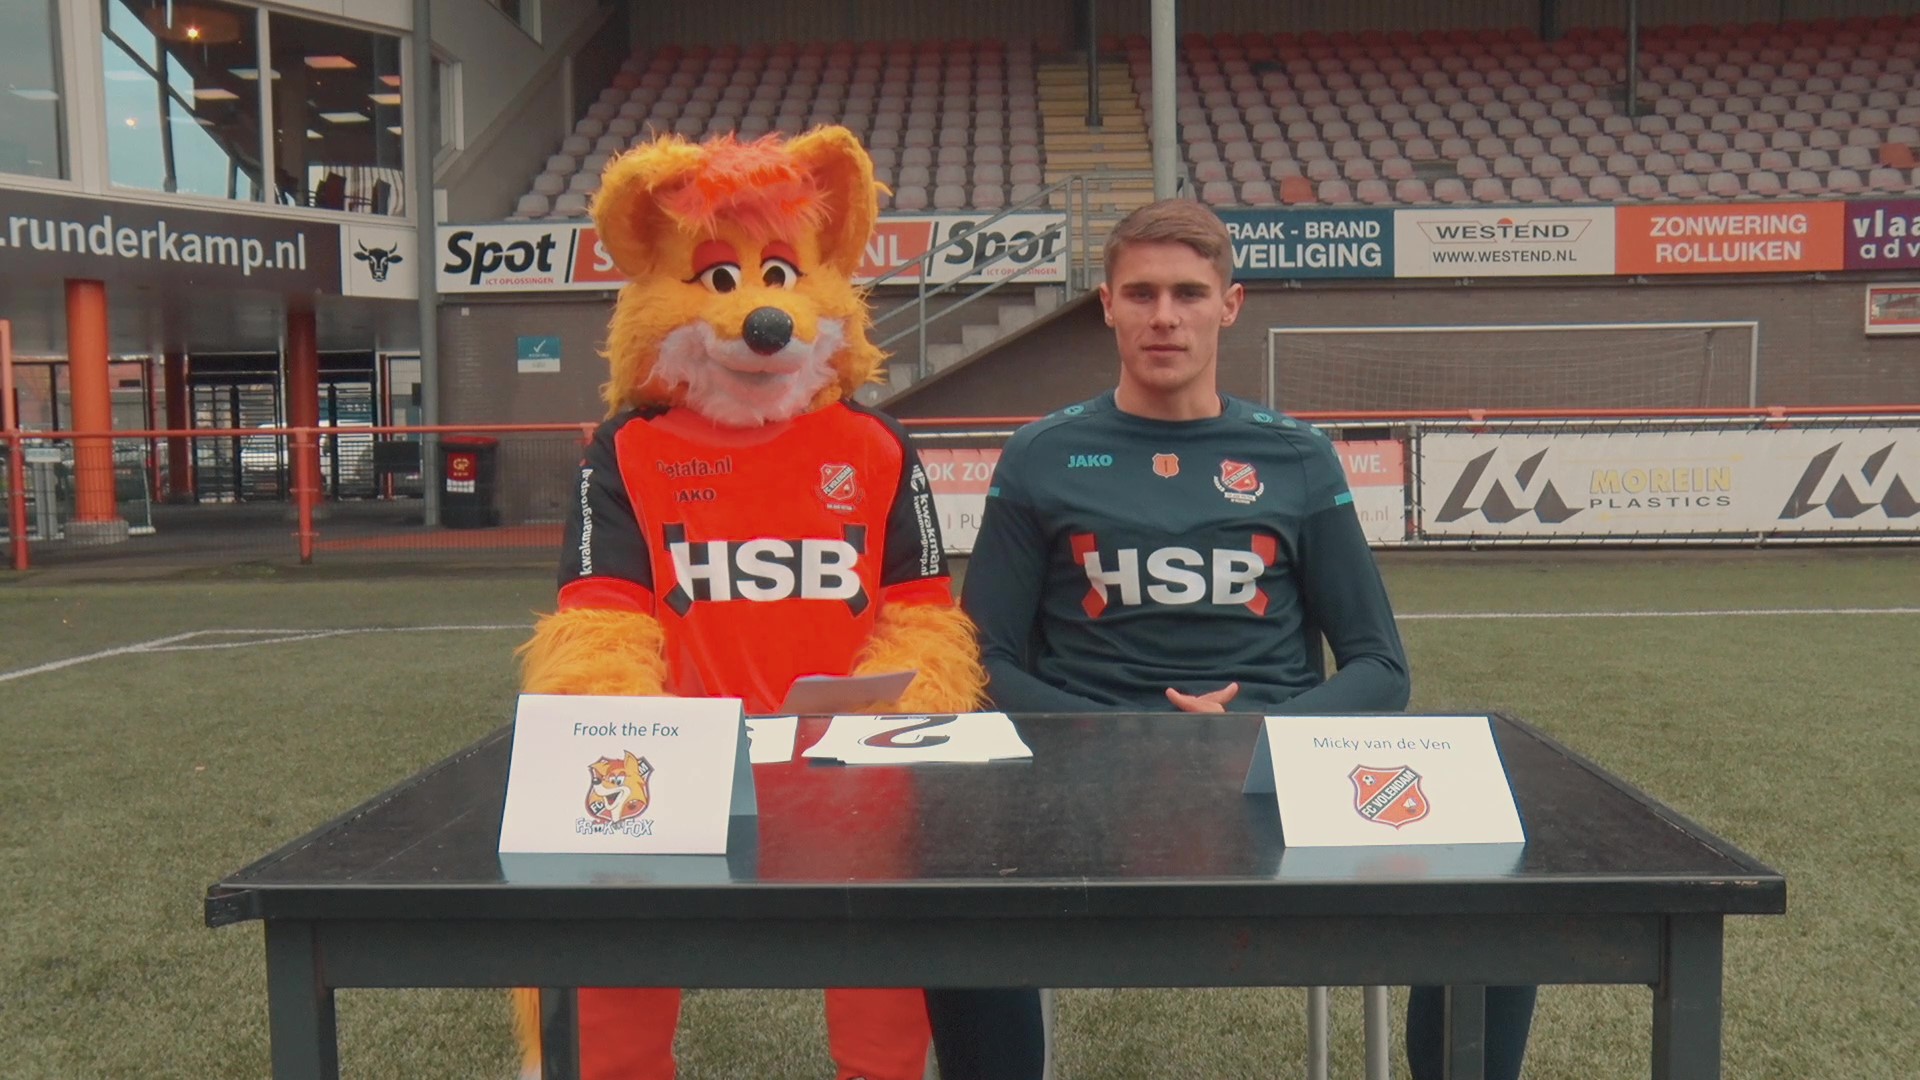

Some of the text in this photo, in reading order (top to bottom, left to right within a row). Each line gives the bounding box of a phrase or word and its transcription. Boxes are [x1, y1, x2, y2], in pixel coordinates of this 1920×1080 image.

[1305, 221, 1381, 239] BRAND
[1436, 224, 1570, 240] WESTEND
[1649, 213, 1808, 237] ZONWERING
[443, 231, 556, 285] Spot
[944, 220, 1061, 276] Spot
[1432, 249, 1577, 264] WWW.WESTEND.NL
[1655, 240, 1801, 264] ROLLUIKEN
[485, 276, 554, 286] ICT OPLOSSINGEN
[1067, 454, 1113, 468] JAKO
[1590, 466, 1732, 494] MOREIN
[1590, 496, 1731, 509] PLASTICS
[920, 493, 940, 575] kwakman
[670, 538, 860, 601] HSB
[1083, 546, 1265, 605] HSB
[573, 722, 679, 737] Frook the Fox
[1314, 737, 1450, 751] Micky van de Ven
[1361, 769, 1416, 818] FC VOLENDAM
